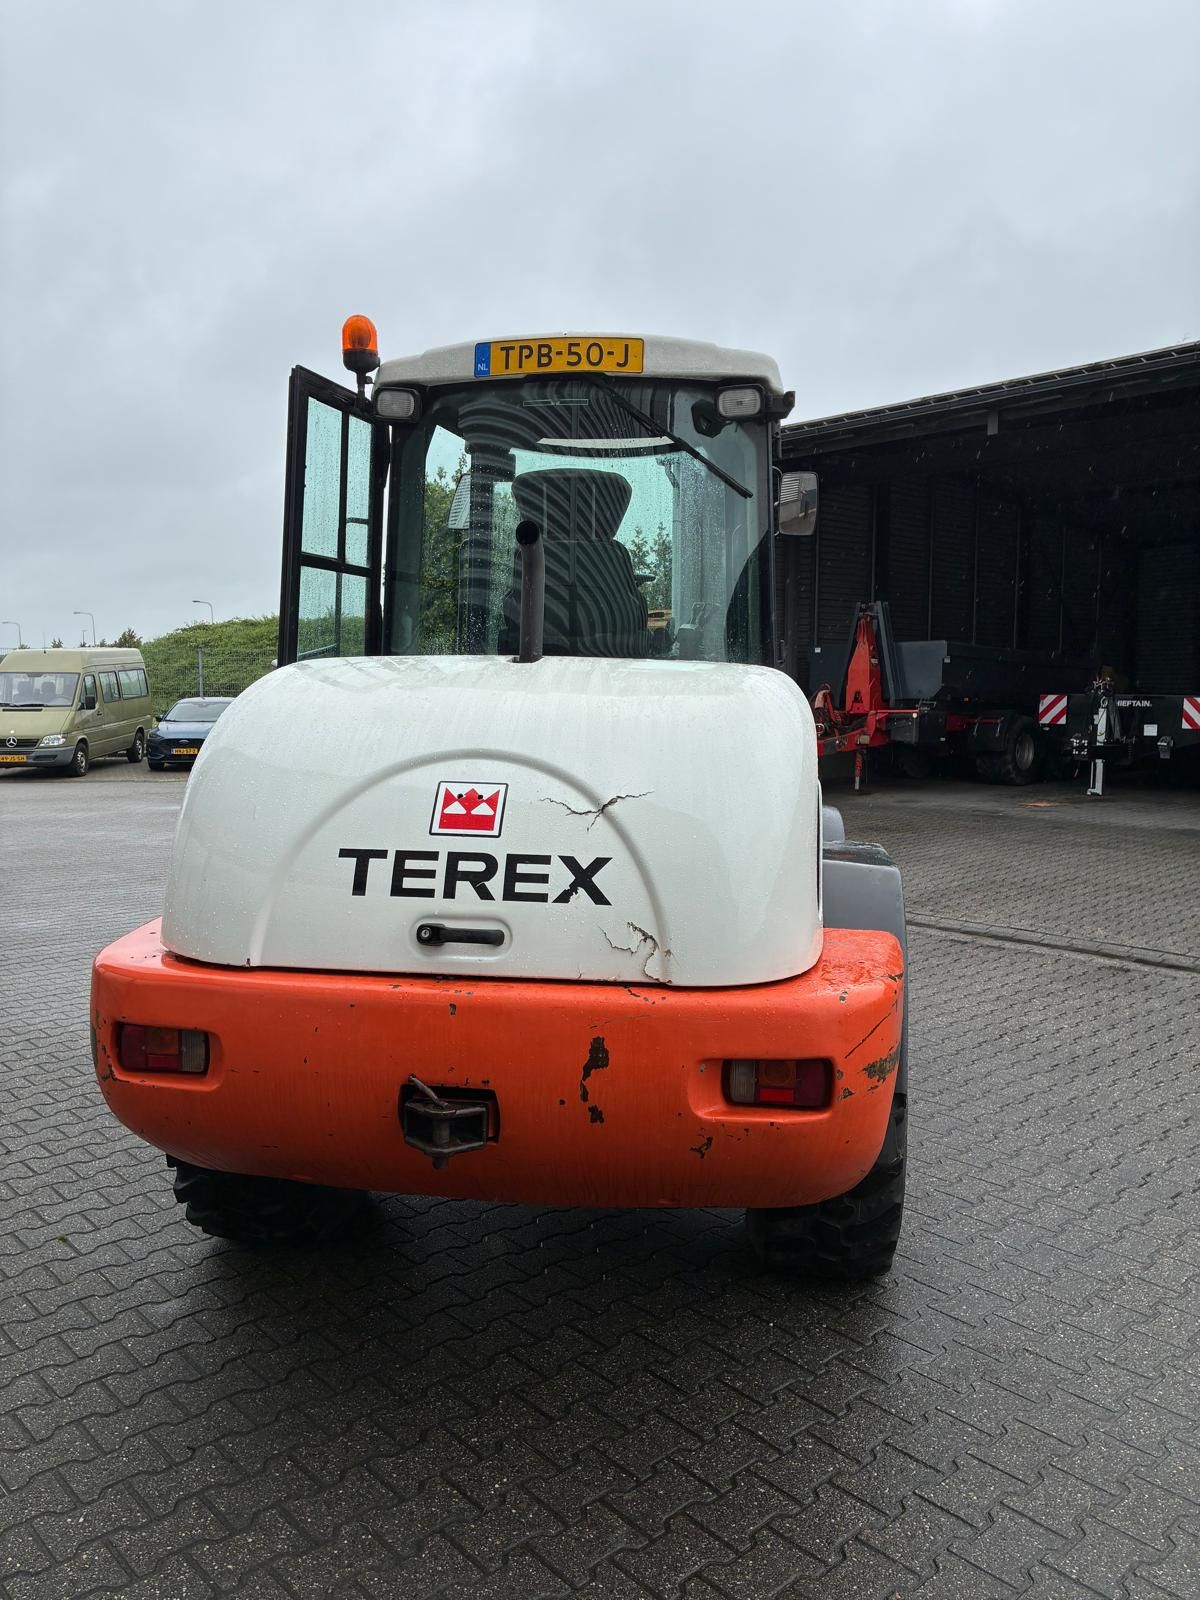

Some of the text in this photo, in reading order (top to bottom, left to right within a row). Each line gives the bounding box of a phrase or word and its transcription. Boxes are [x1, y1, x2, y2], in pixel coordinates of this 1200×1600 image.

[477, 342, 629, 371] NL TPB-50-J
[338, 848, 613, 905] TEREX
